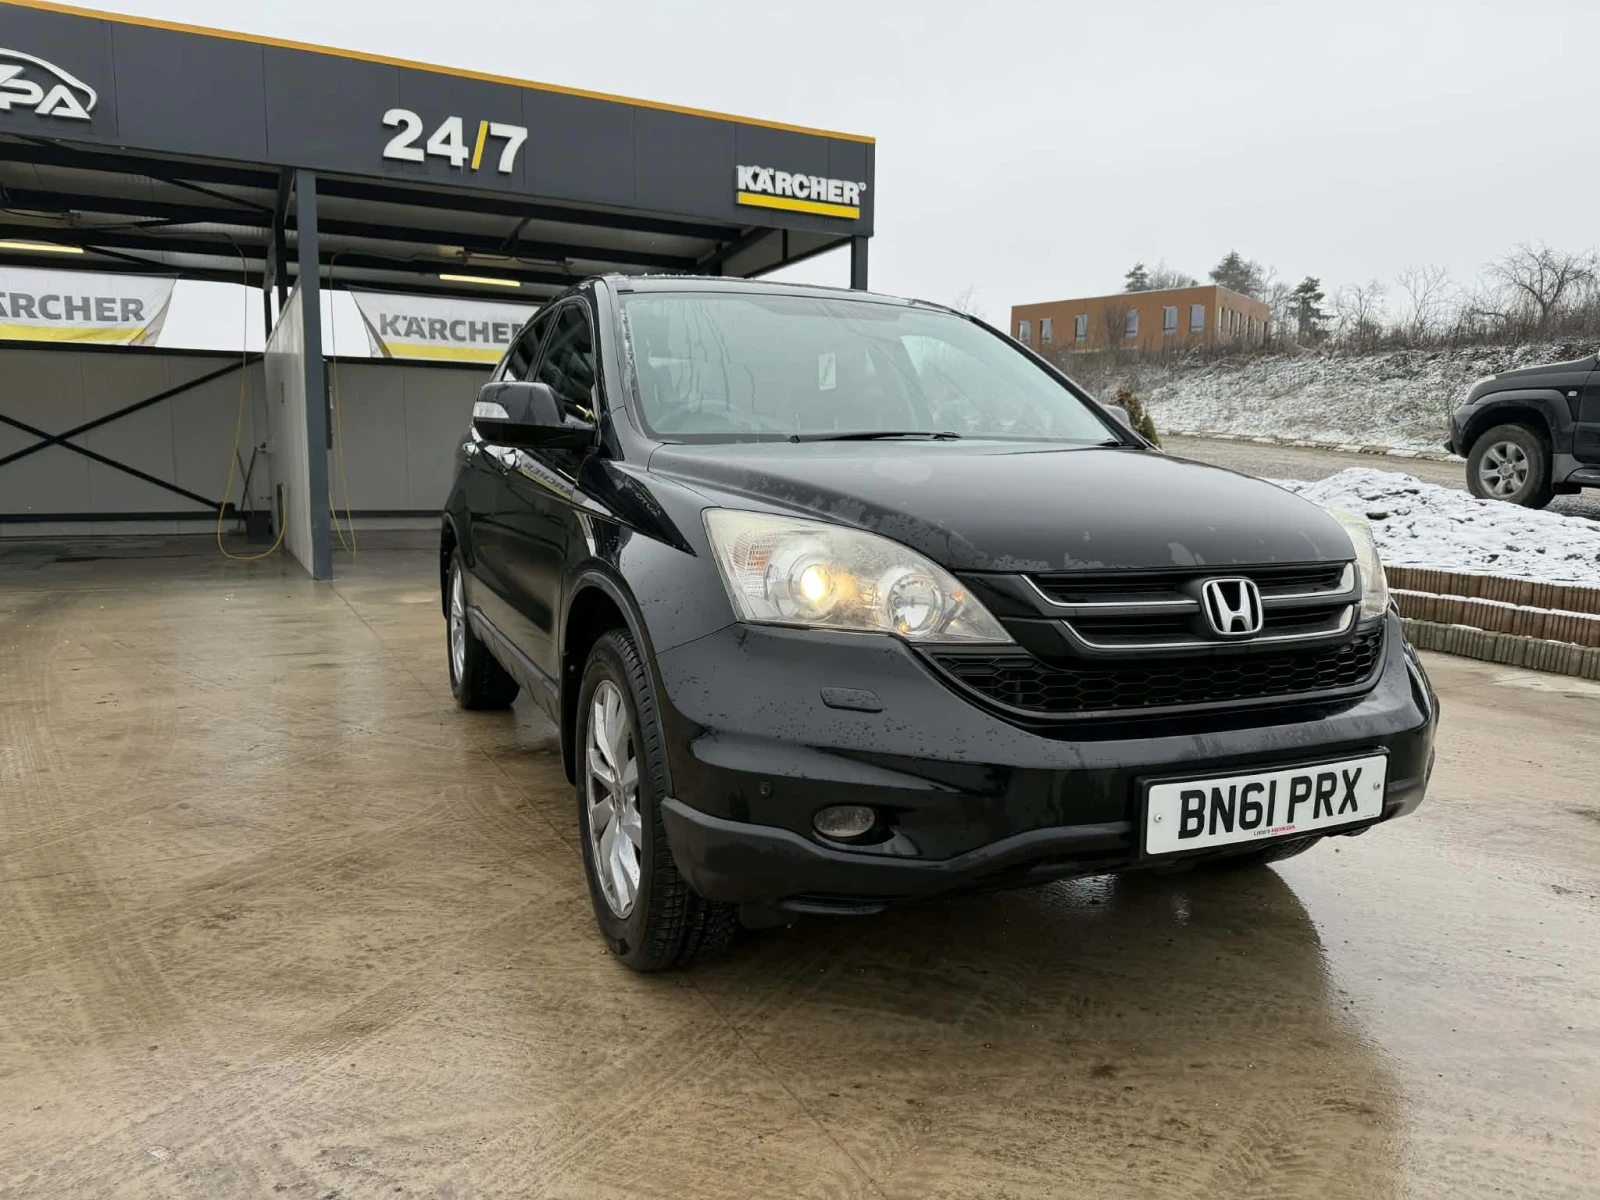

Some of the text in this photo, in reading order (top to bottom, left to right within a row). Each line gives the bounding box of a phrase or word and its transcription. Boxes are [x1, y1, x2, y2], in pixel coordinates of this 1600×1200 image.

[382, 108, 528, 173] 24/7
[1178, 767, 1362, 839] BN61 PRX
